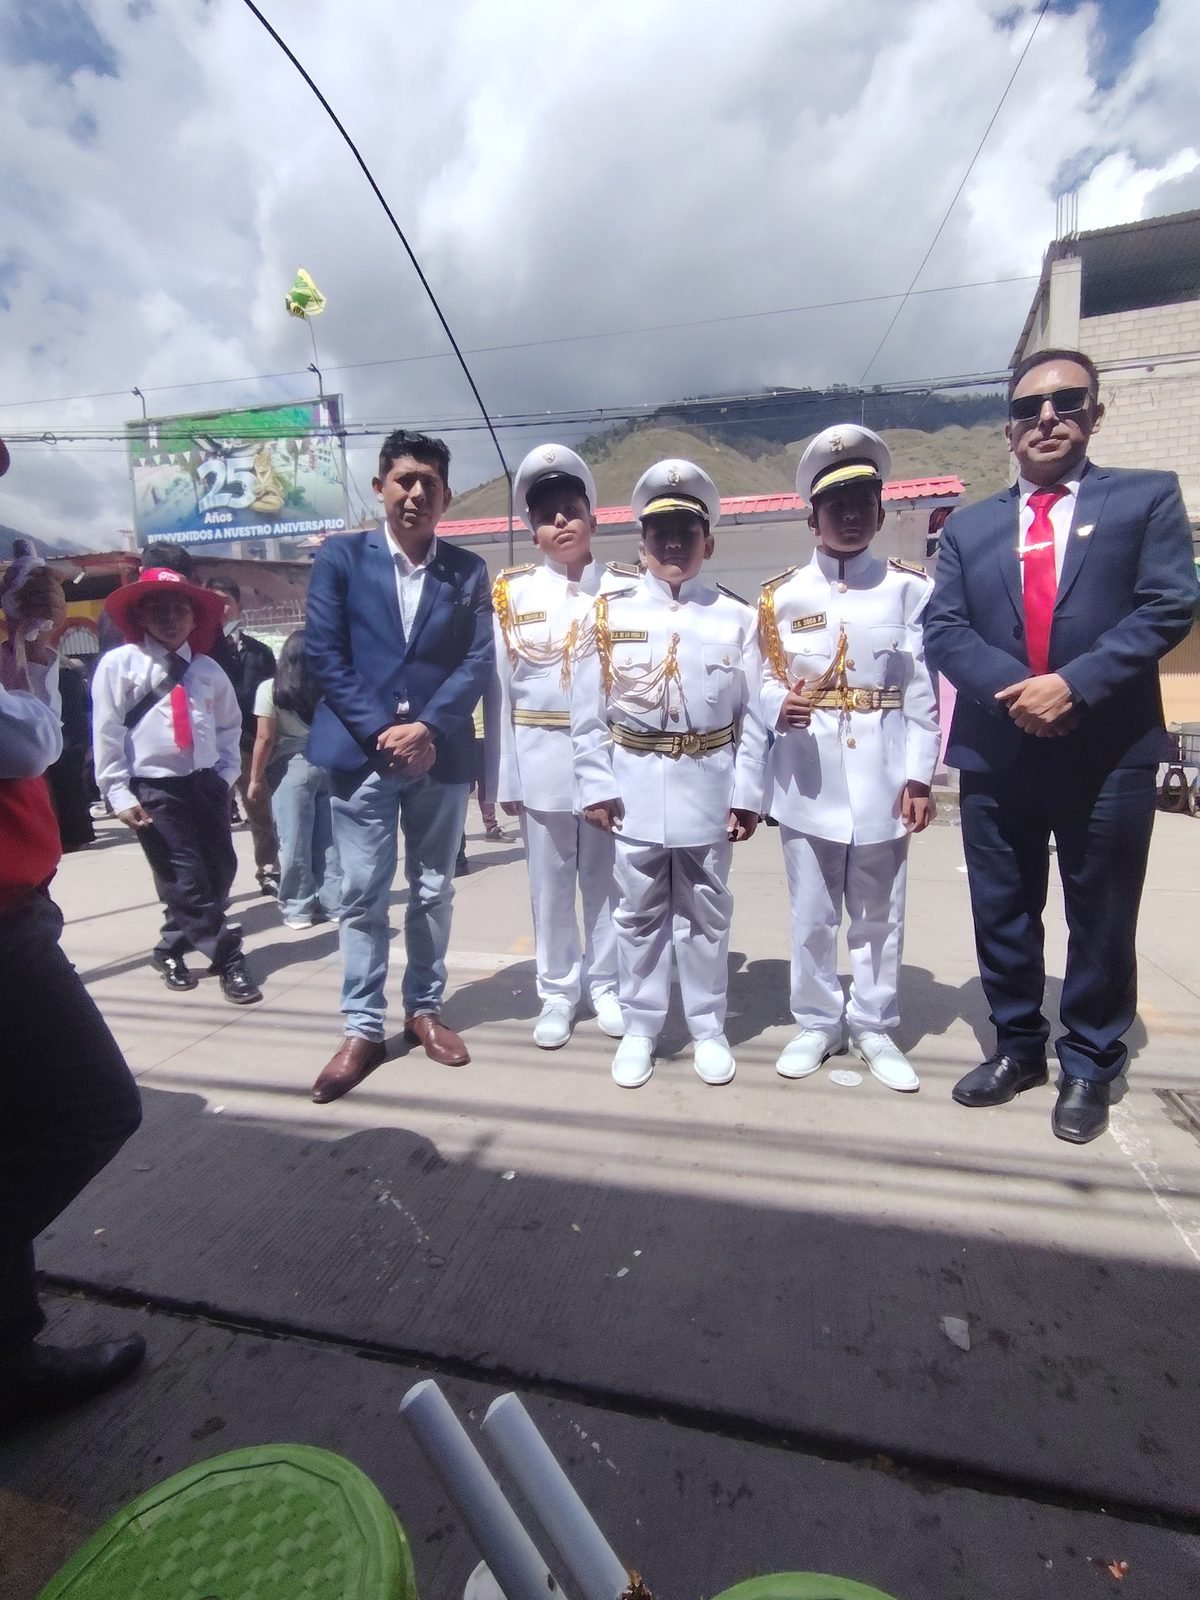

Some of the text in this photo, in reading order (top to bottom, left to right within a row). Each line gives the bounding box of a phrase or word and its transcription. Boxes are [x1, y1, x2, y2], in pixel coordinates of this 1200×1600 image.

[197, 457, 257, 513] 25
[204, 511, 233, 524] Años
[147, 518, 344, 545] BIENVENIDOS A NUESTRO ANIVERSARIO
